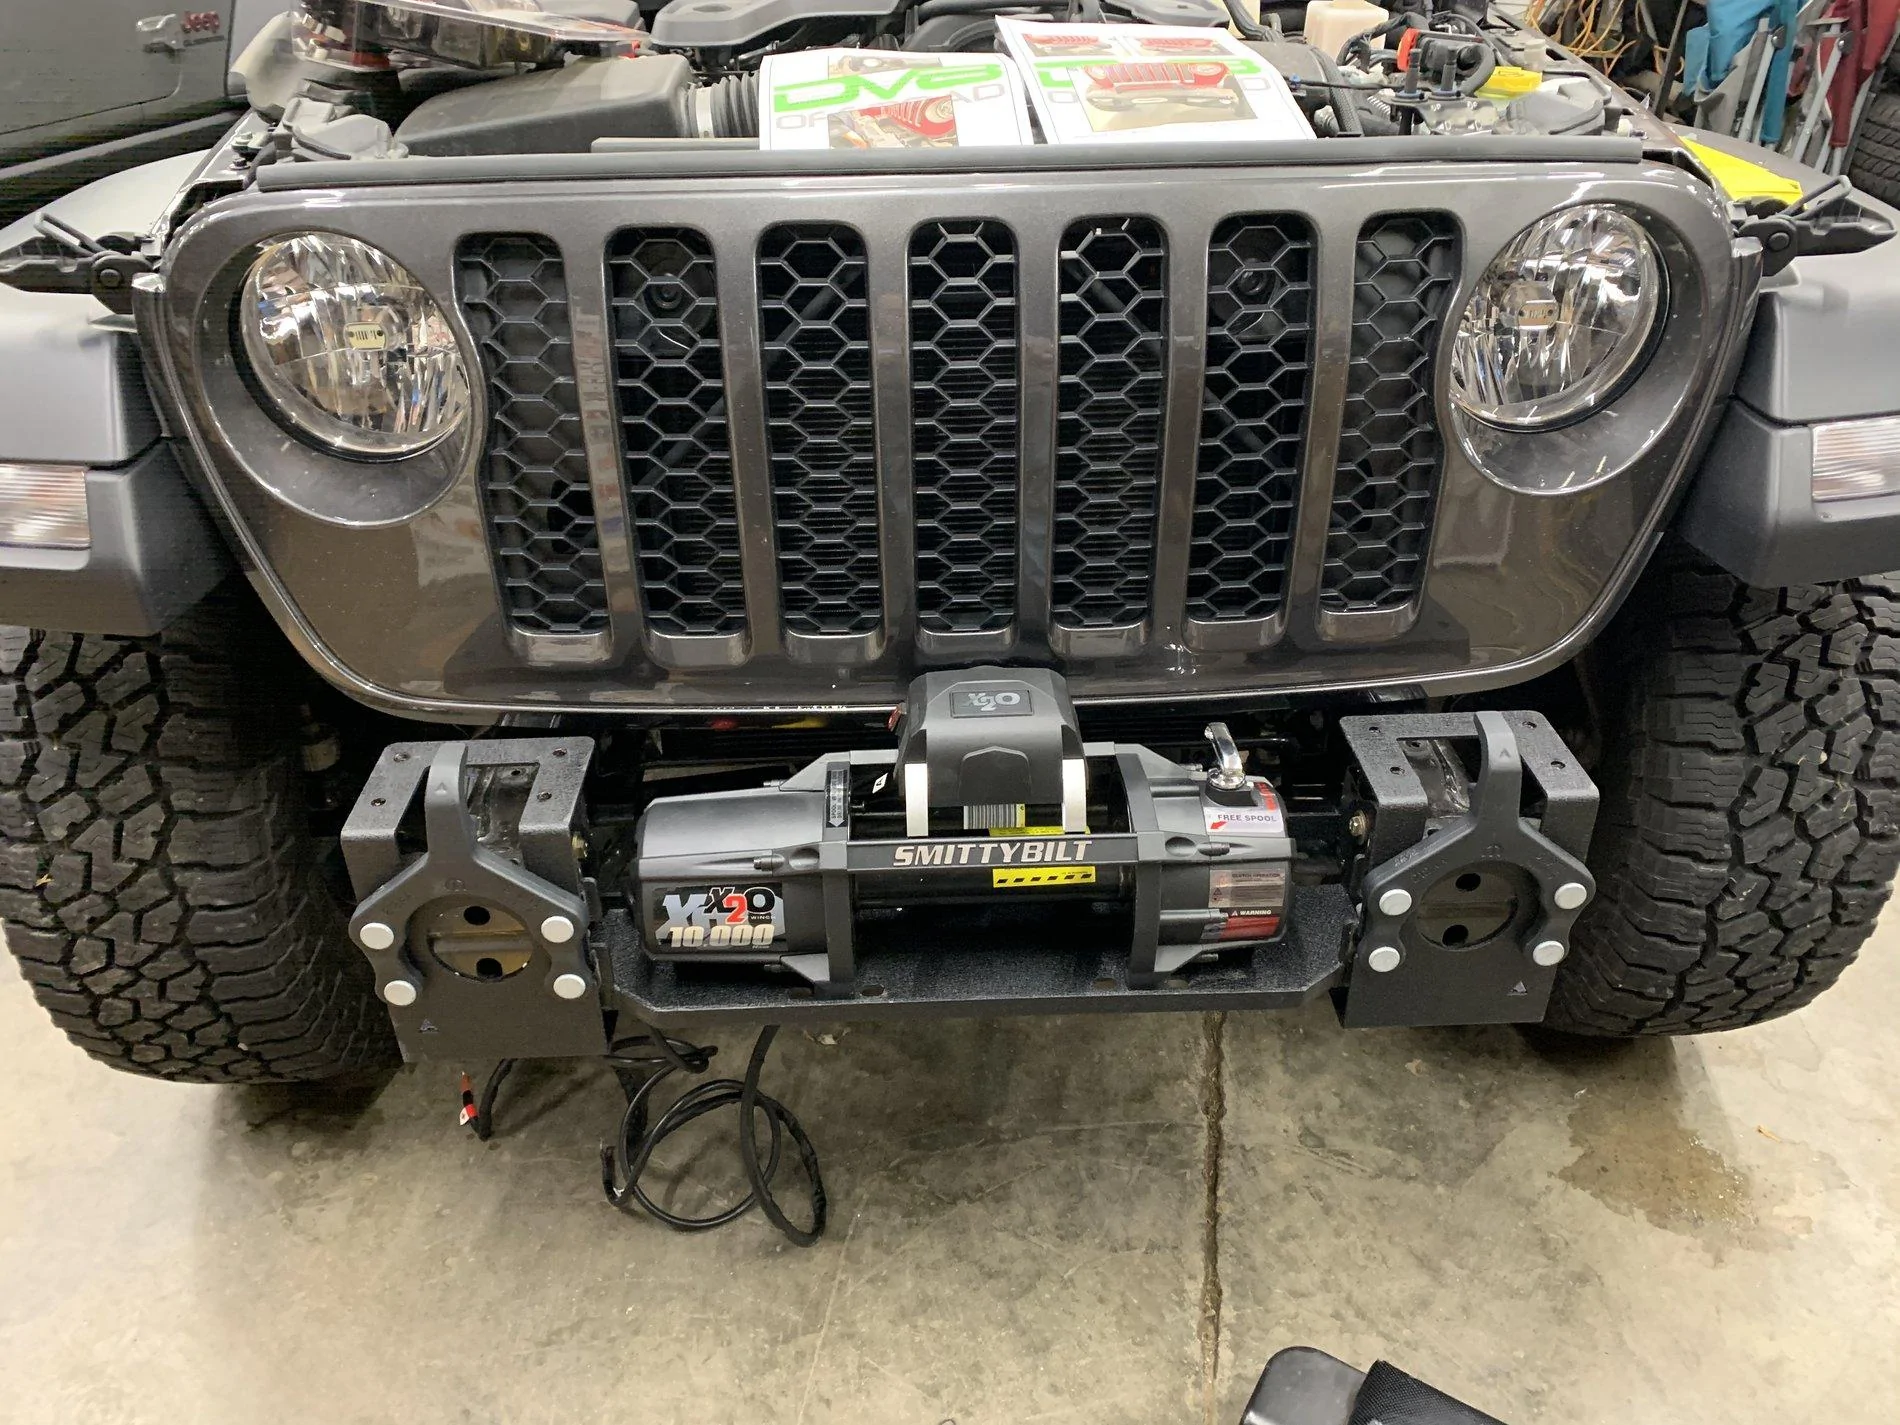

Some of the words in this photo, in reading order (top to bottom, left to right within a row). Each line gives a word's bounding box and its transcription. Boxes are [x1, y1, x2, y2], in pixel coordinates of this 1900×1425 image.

[183, 11, 219, 33] Jeep
[1244, 814, 1277, 823] SPOOL
[893, 841, 1092, 866] SMITTYBILT
[1239, 909, 1272, 917] WARNING
